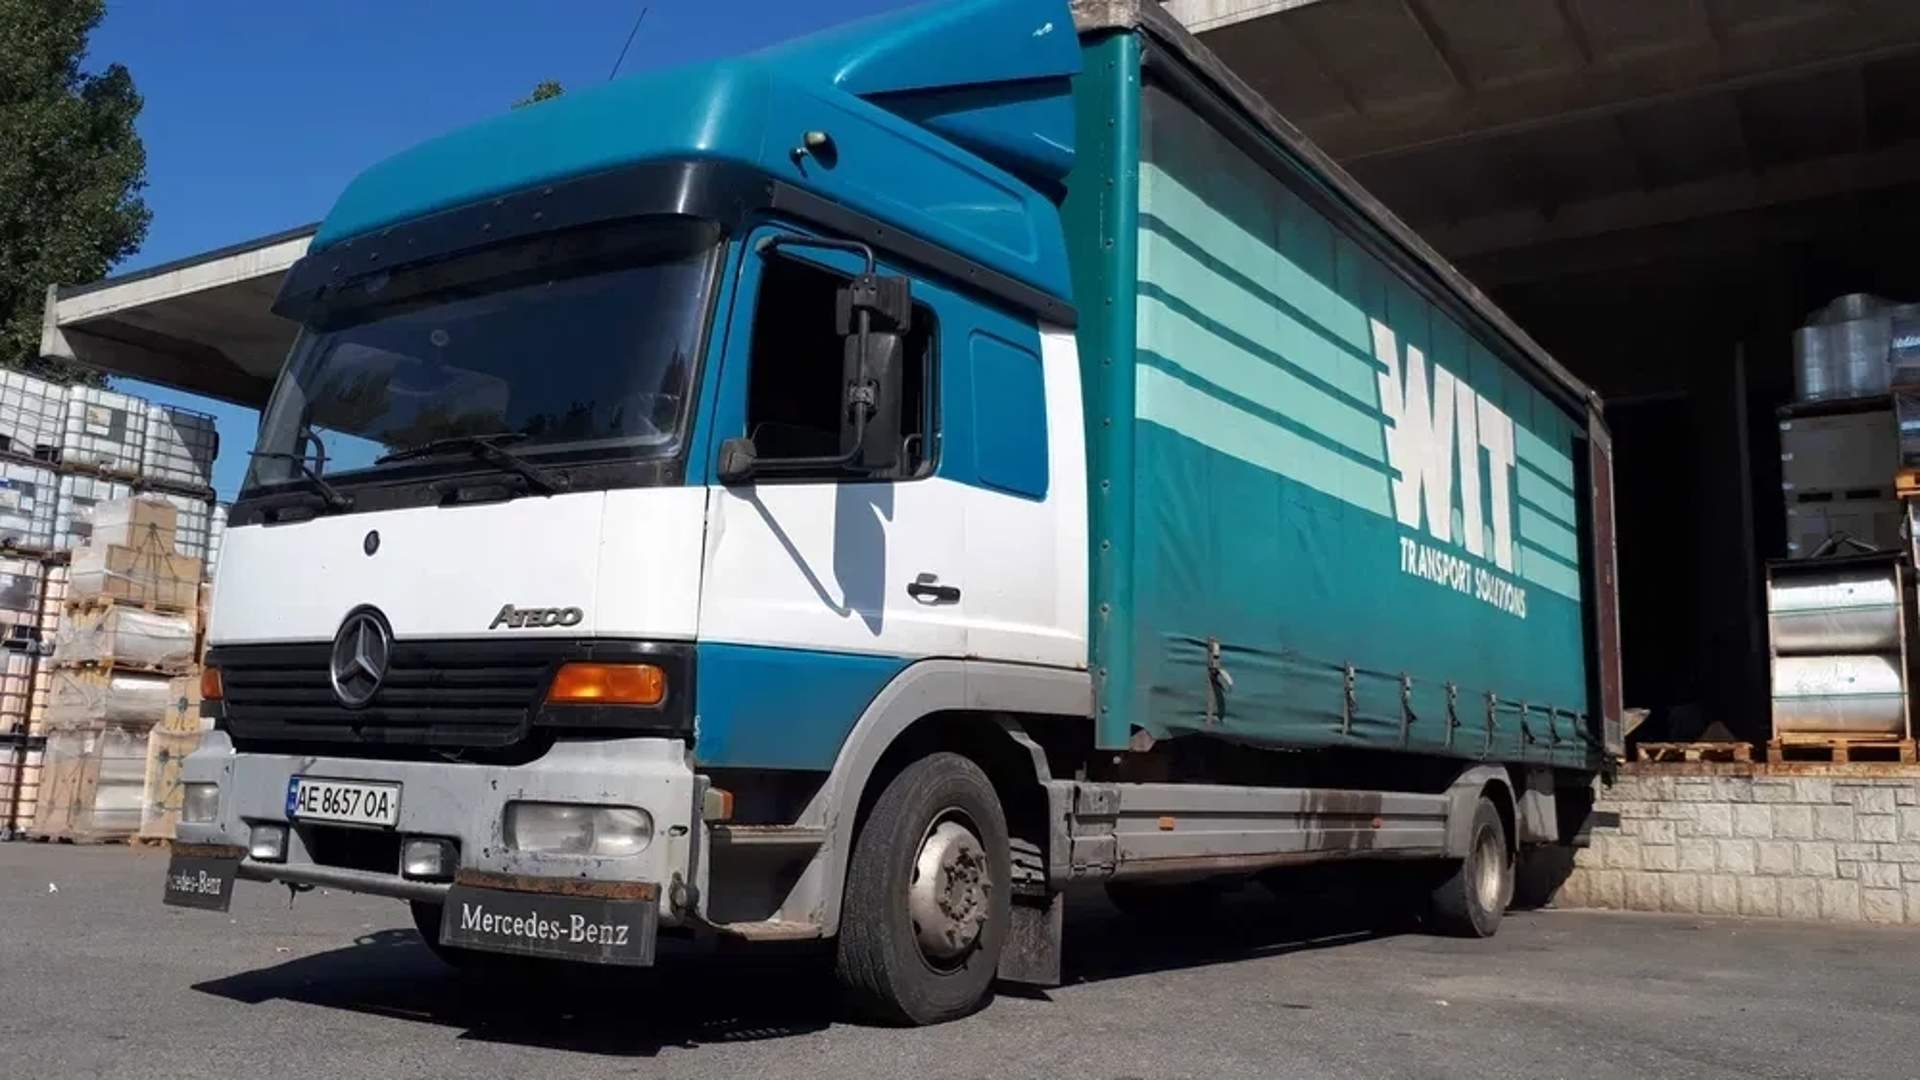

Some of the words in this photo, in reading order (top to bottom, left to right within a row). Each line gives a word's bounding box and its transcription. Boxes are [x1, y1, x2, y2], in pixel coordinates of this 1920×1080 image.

[1399, 536, 1471, 595] TRANSPORT
[1474, 567, 1526, 619] SOLUTIONS
[296, 786, 320, 812] AE
[322, 787, 362, 816] 8657
[364, 791, 388, 818] OA
[460, 903, 629, 945] Mercedes-Benz
